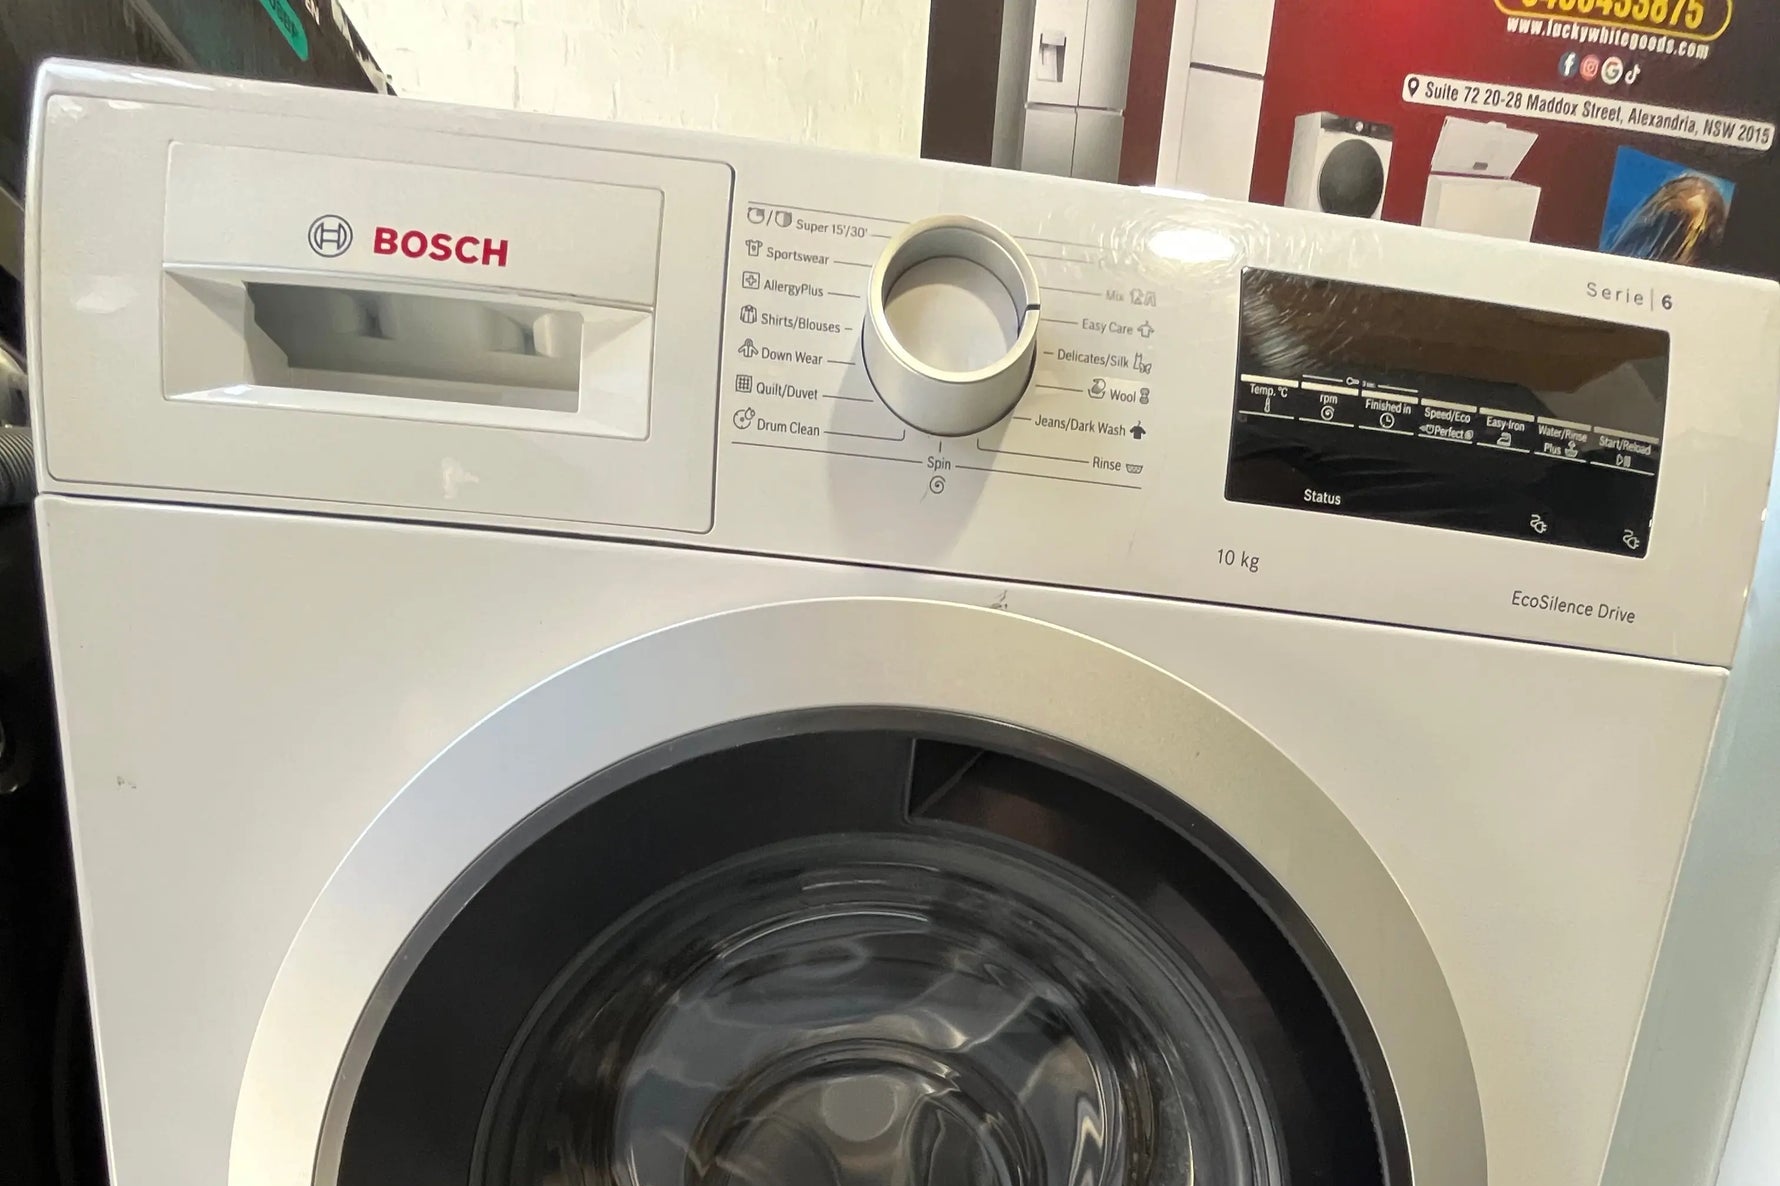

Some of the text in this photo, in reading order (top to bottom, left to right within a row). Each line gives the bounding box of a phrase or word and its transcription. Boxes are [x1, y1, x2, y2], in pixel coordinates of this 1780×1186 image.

[1507, 17, 1710, 60] www.luckywhitegoods.com
[1425, 81, 1770, 145] Suite 72 20-28 Maddox Street, Alexandria, NSW 2015
[796, 219, 828, 234] Super
[373, 226, 509, 267] BOSCH
[766, 247, 829, 265] Sportswear
[764, 279, 824, 296] AllergyPlus
[1106, 289, 1124, 302] Mix
[1587, 282, 1673, 310] Serie 6
[761, 313, 841, 333] Shirts/Blouses
[1082, 318, 1133, 335] Easy Care
[761, 348, 823, 365] Down Wear
[1057, 349, 1129, 368] Delicates/Silk
[756, 382, 818, 400] Quilt/Duvet
[1110, 389, 1136, 403] Wool
[1250, 383, 1276, 397] Temp.
[1320, 394, 1338, 404] rpm
[1365, 399, 1412, 415] Finished in
[1424, 407, 1471, 423] Speed/Eco
[757, 418, 820, 436] Drum Clean
[1035, 414, 1126, 436] Jeans/Dark Wash
[1538, 424, 1588, 442] Water/Rinse
[1544, 442, 1562, 455] Plus
[1599, 436, 1652, 455] Start/Reload
[927, 456, 951, 471] Spin
[1093, 457, 1121, 471] Rinse
[1303, 488, 1341, 506] Status
[1217, 548, 1260, 573] 10 kg
[1511, 590, 1636, 624] EcoSilence Drive
